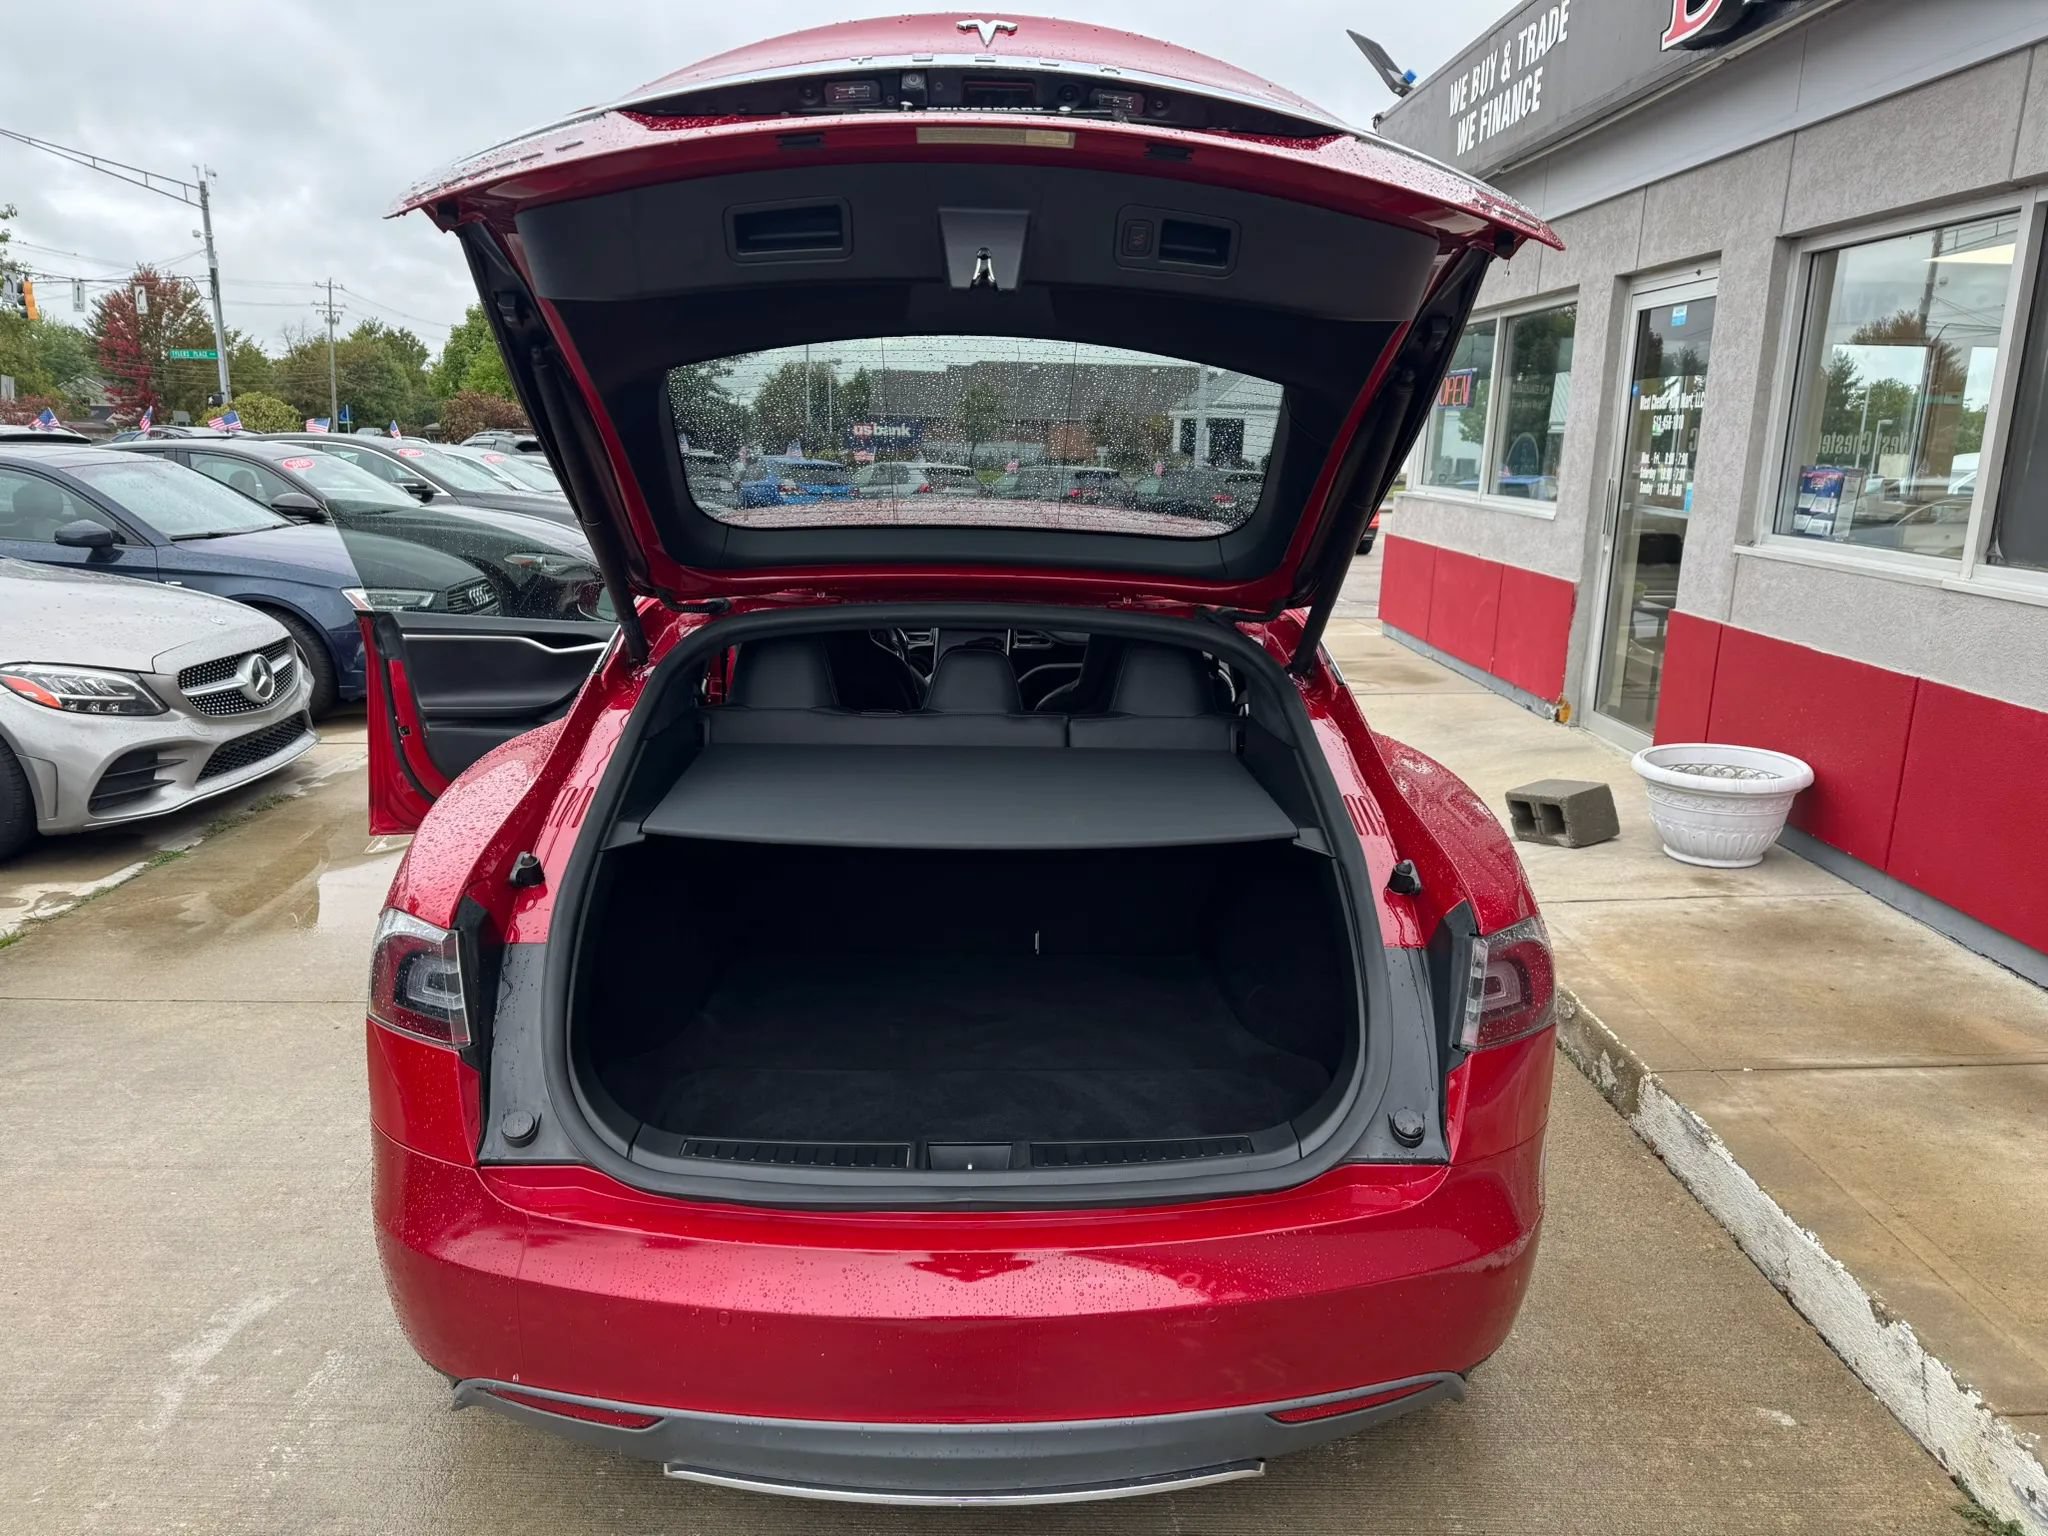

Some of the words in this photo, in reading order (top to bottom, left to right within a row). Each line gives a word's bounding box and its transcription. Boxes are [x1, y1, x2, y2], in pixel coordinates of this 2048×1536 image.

[1449, 72, 1469, 118] WE
[1470, 47, 1499, 104] BUY
[1501, 40, 1511, 83] &
[1518, 0, 1571, 70] TRADE
[1457, 110, 1477, 156] WE
[1479, 66, 1543, 144] FINANCE
[1438, 375, 1472, 407] OPEN
